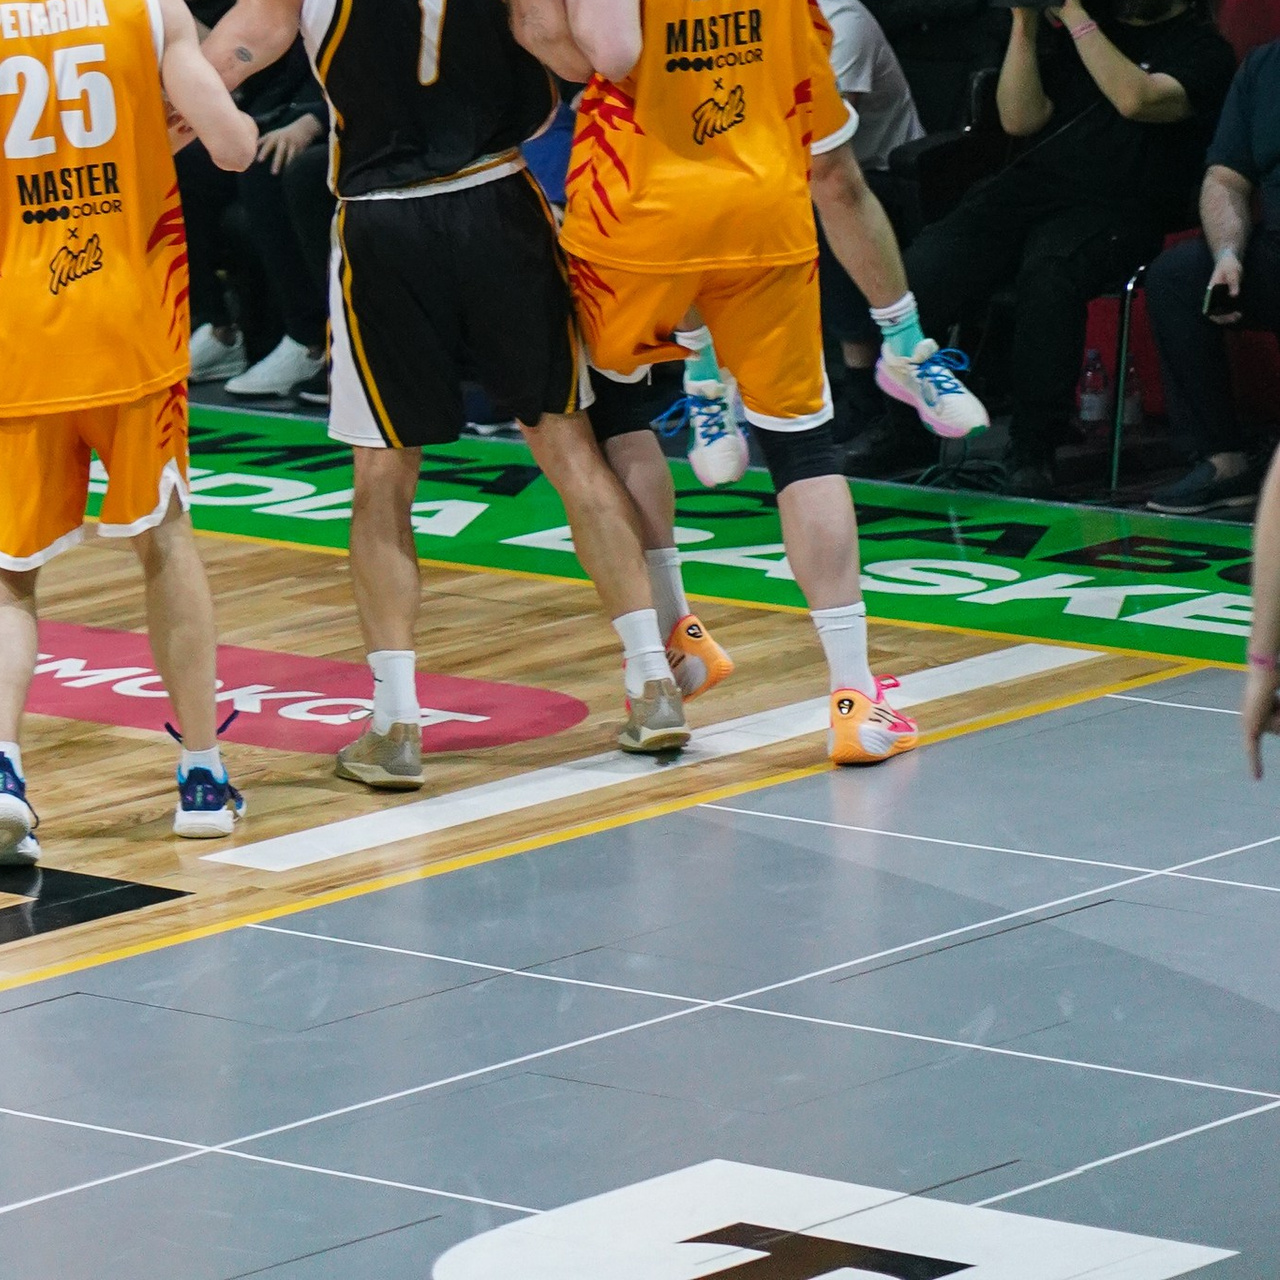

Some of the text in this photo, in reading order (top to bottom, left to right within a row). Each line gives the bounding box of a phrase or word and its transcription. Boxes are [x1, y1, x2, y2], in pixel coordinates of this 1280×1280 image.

[666, 9, 763, 55] MASTER
[715, 48, 764, 68] COLOR
[16, 162, 121, 206] MASTER
[70, 200, 122, 219] COLOR
